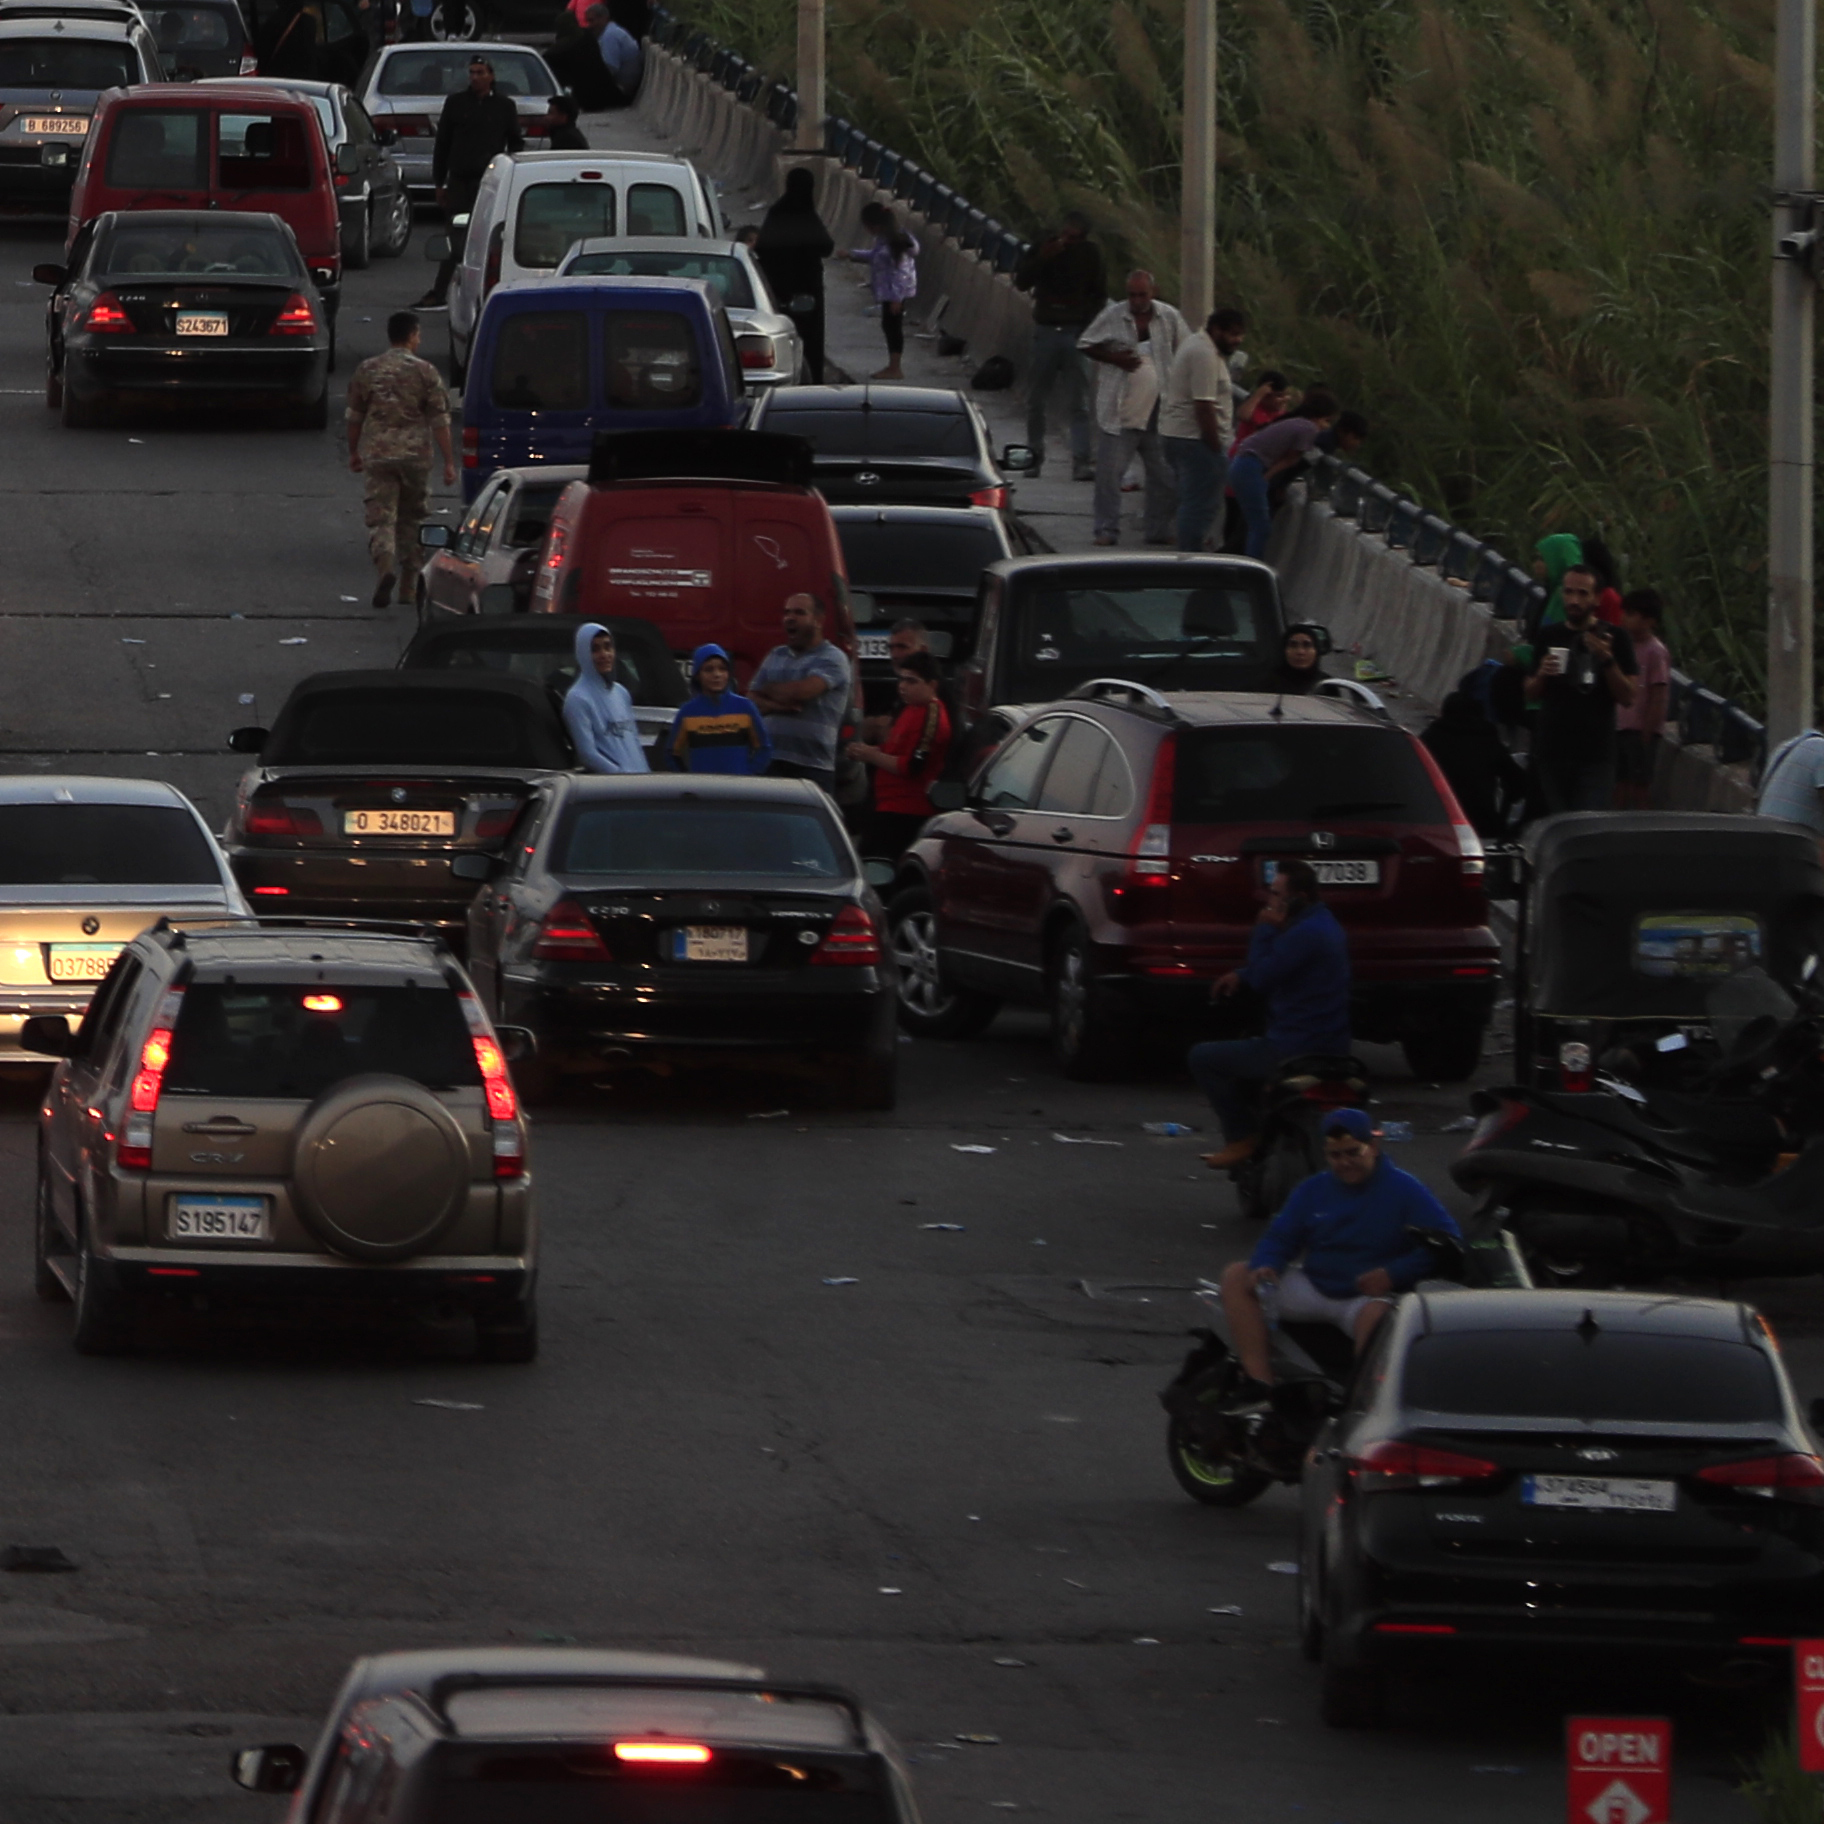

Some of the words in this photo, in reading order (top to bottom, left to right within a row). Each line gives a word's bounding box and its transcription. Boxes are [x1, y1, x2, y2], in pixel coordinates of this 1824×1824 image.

[28, 118, 37, 131] B
[378, 815, 441, 832] 348021
[176, 1211, 262, 1236] S195147
[1578, 1732, 1661, 1765] OPEN
